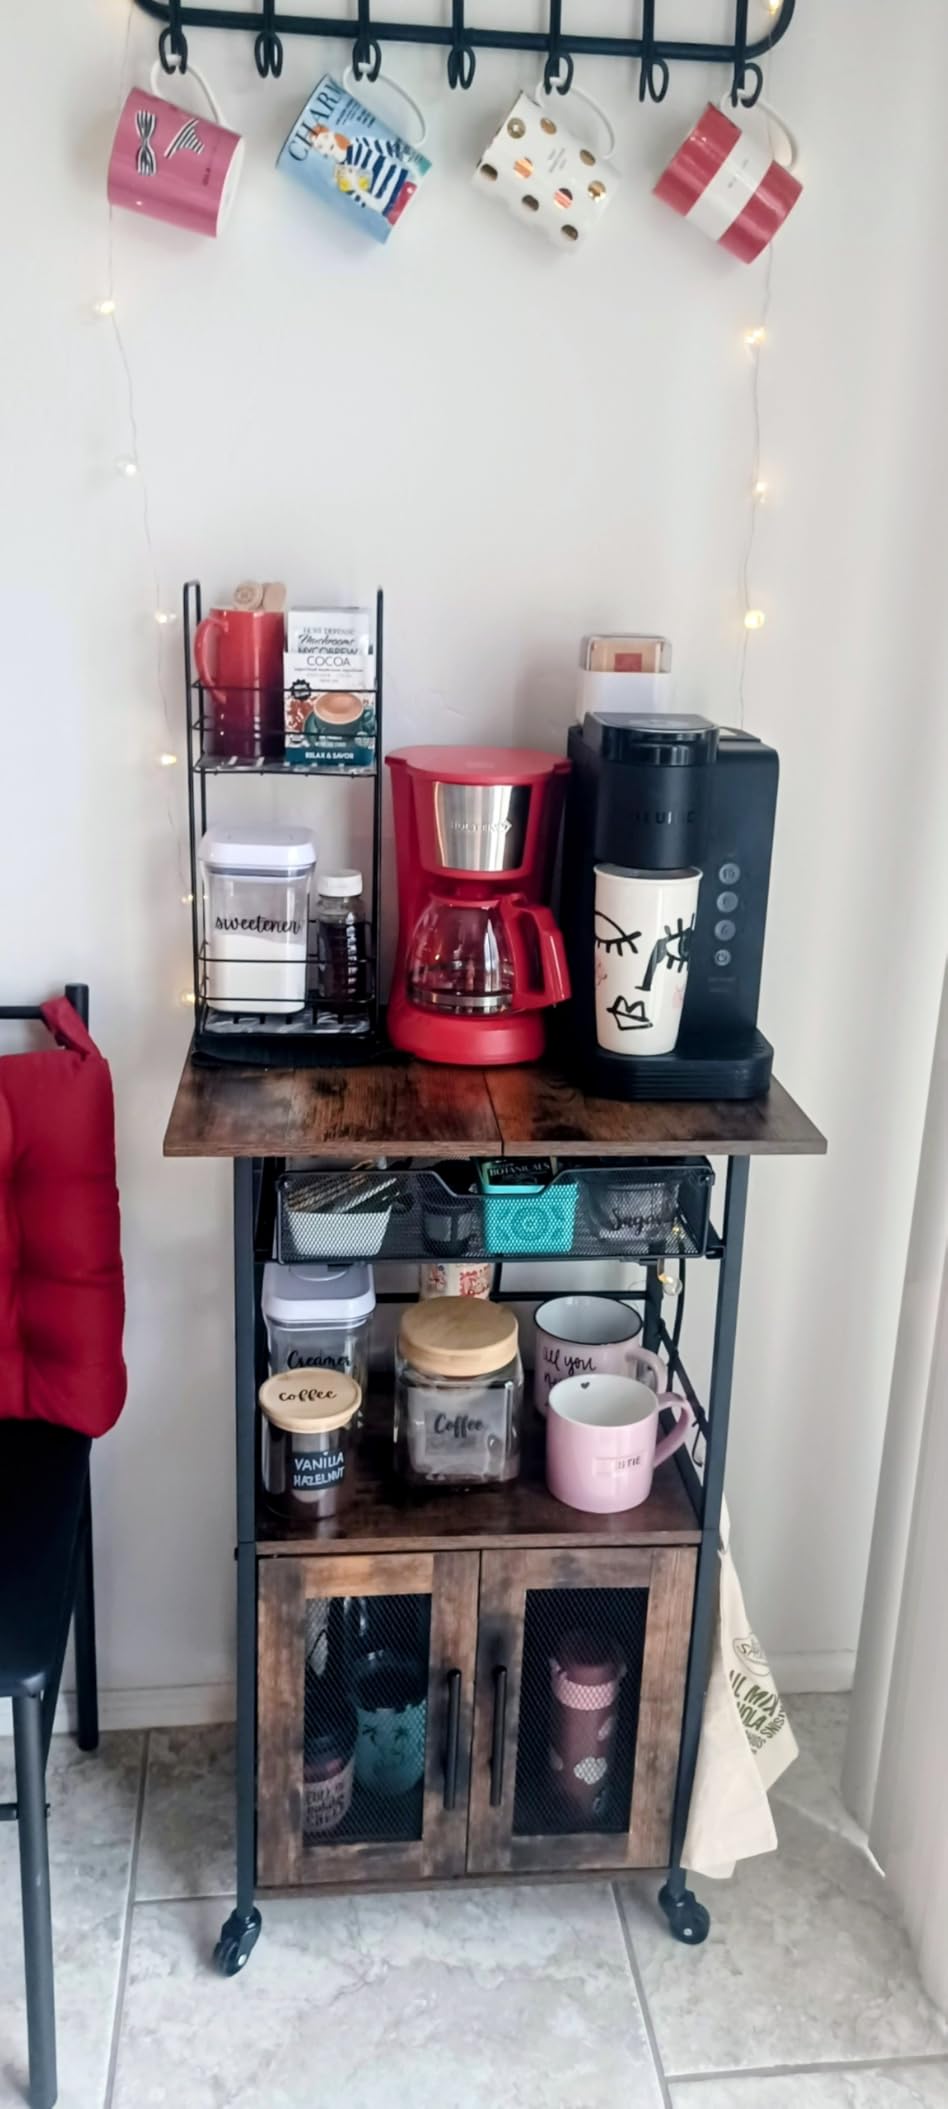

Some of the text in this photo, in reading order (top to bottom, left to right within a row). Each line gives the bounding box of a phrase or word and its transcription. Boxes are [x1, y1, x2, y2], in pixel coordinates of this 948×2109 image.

[306, 656, 351, 667] COCOA
[304, 751, 325, 760] RELAX
[332, 751, 354, 760] SAVOR
[214, 915, 302, 936] sweetener
[287, 1349, 353, 1370] Creamer
[564, 1356, 597, 1377] you
[278, 1388, 338, 1403] coffee
[433, 1412, 485, 1439] Coffee
[293, 1466, 345, 1487] HAZELNUT
[743, 1684, 780, 1717] MIX
